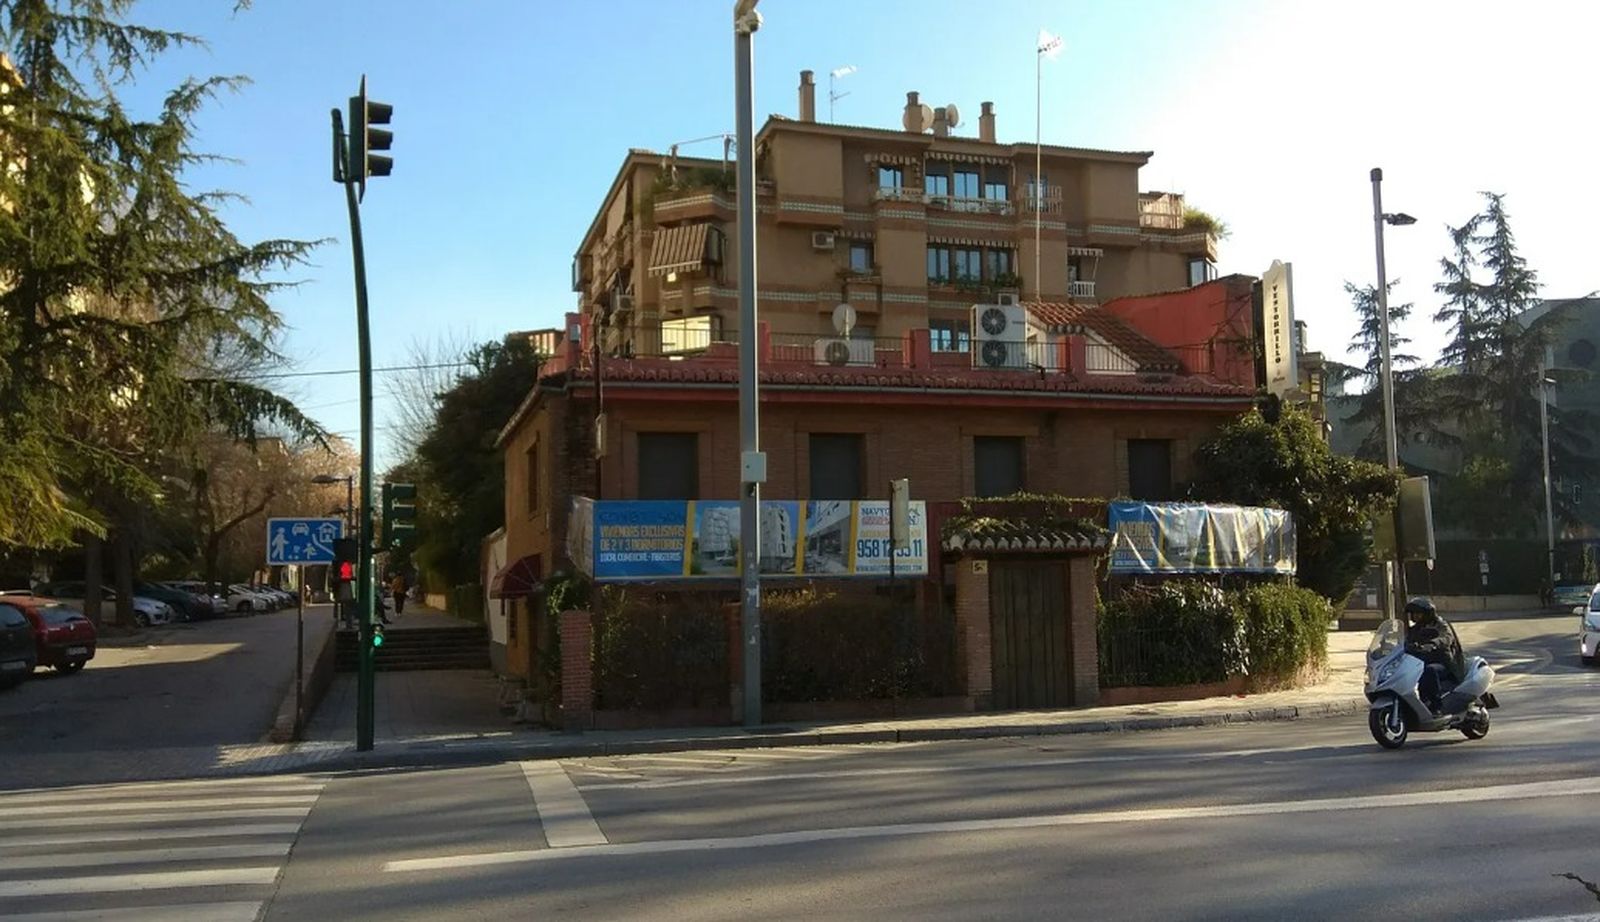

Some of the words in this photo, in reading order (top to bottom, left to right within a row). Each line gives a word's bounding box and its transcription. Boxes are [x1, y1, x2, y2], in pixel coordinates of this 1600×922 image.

[1273, 285, 1281, 363] VENTORRILLO
[610, 539, 617, 551] 2
[624, 539, 631, 551] 3
[857, 539, 880, 557] 958
[913, 539, 922, 557] 11
